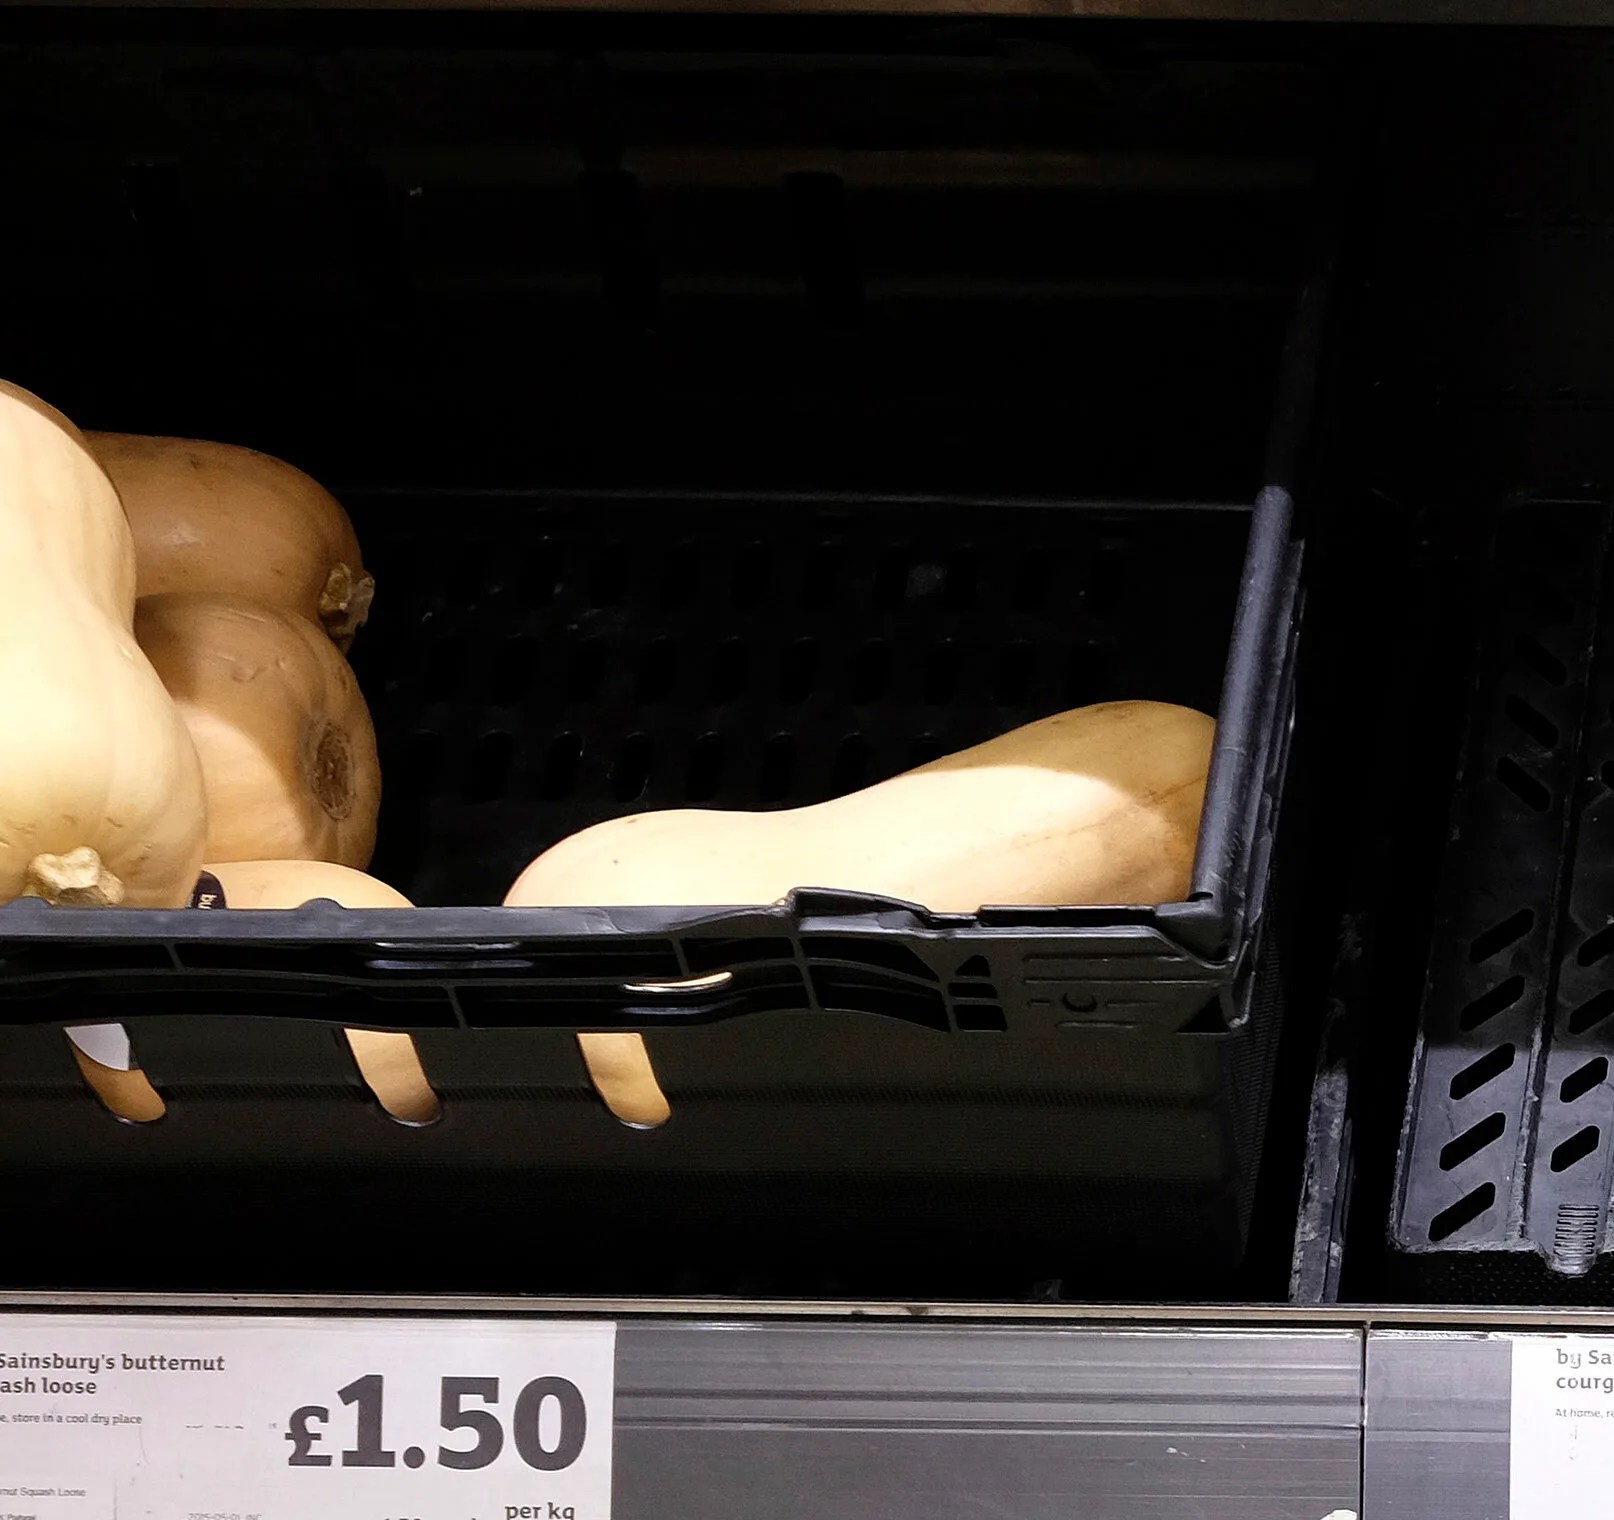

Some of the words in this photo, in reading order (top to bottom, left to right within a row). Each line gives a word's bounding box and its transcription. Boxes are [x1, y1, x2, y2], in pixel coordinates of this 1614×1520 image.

[122, 1353, 225, 1371] butternut
[1556, 1348, 1582, 1368] by
[0, 1377, 36, 1394] ash
[42, 1376, 97, 1394] loose
[12, 1414, 40, 1424] store
[43, 1413, 54, 1423] in
[65, 1413, 89, 1424] cool
[91, 1413, 110, 1427] dry
[112, 1414, 143, 1427] place
[284, 1373, 589, 1471] £1.50
[58, 1487, 87, 1498] Loose
